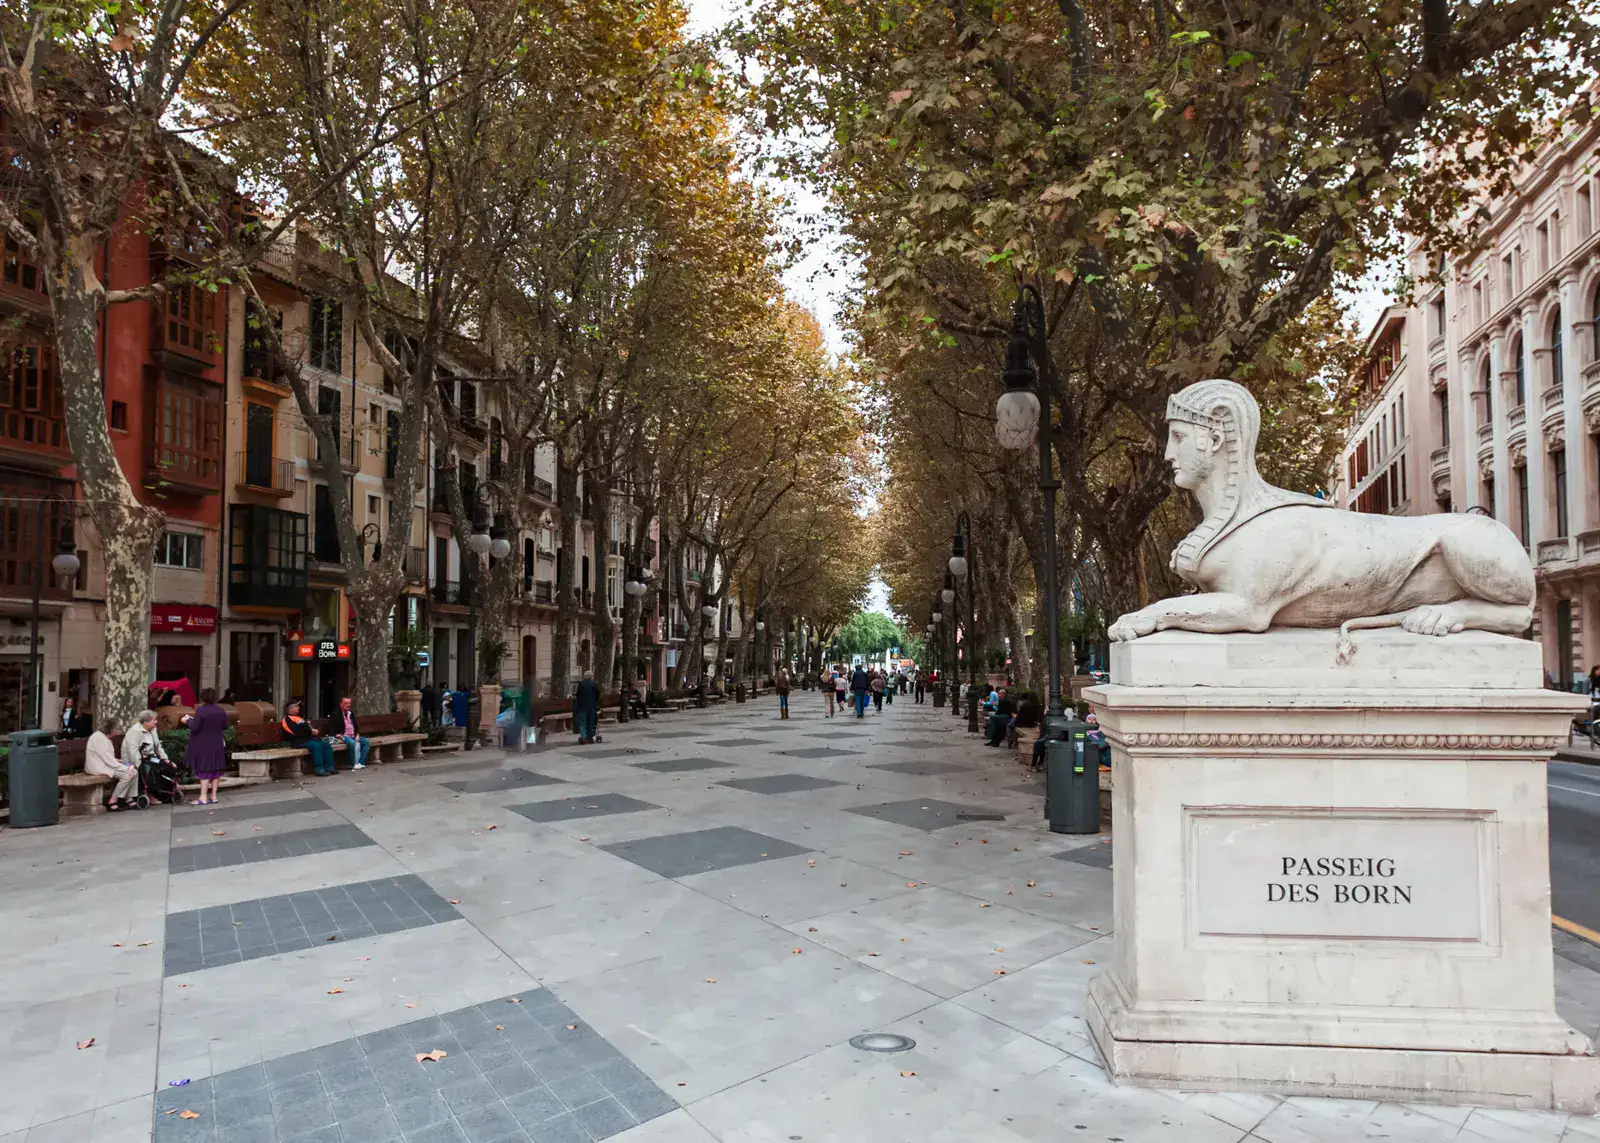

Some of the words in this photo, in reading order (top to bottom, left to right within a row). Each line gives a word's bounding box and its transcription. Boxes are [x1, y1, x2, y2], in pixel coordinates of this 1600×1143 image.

[1280, 856, 1397, 878] PASSEIG
[1266, 883, 1319, 903] DES
[1333, 884, 1412, 904] BORN
